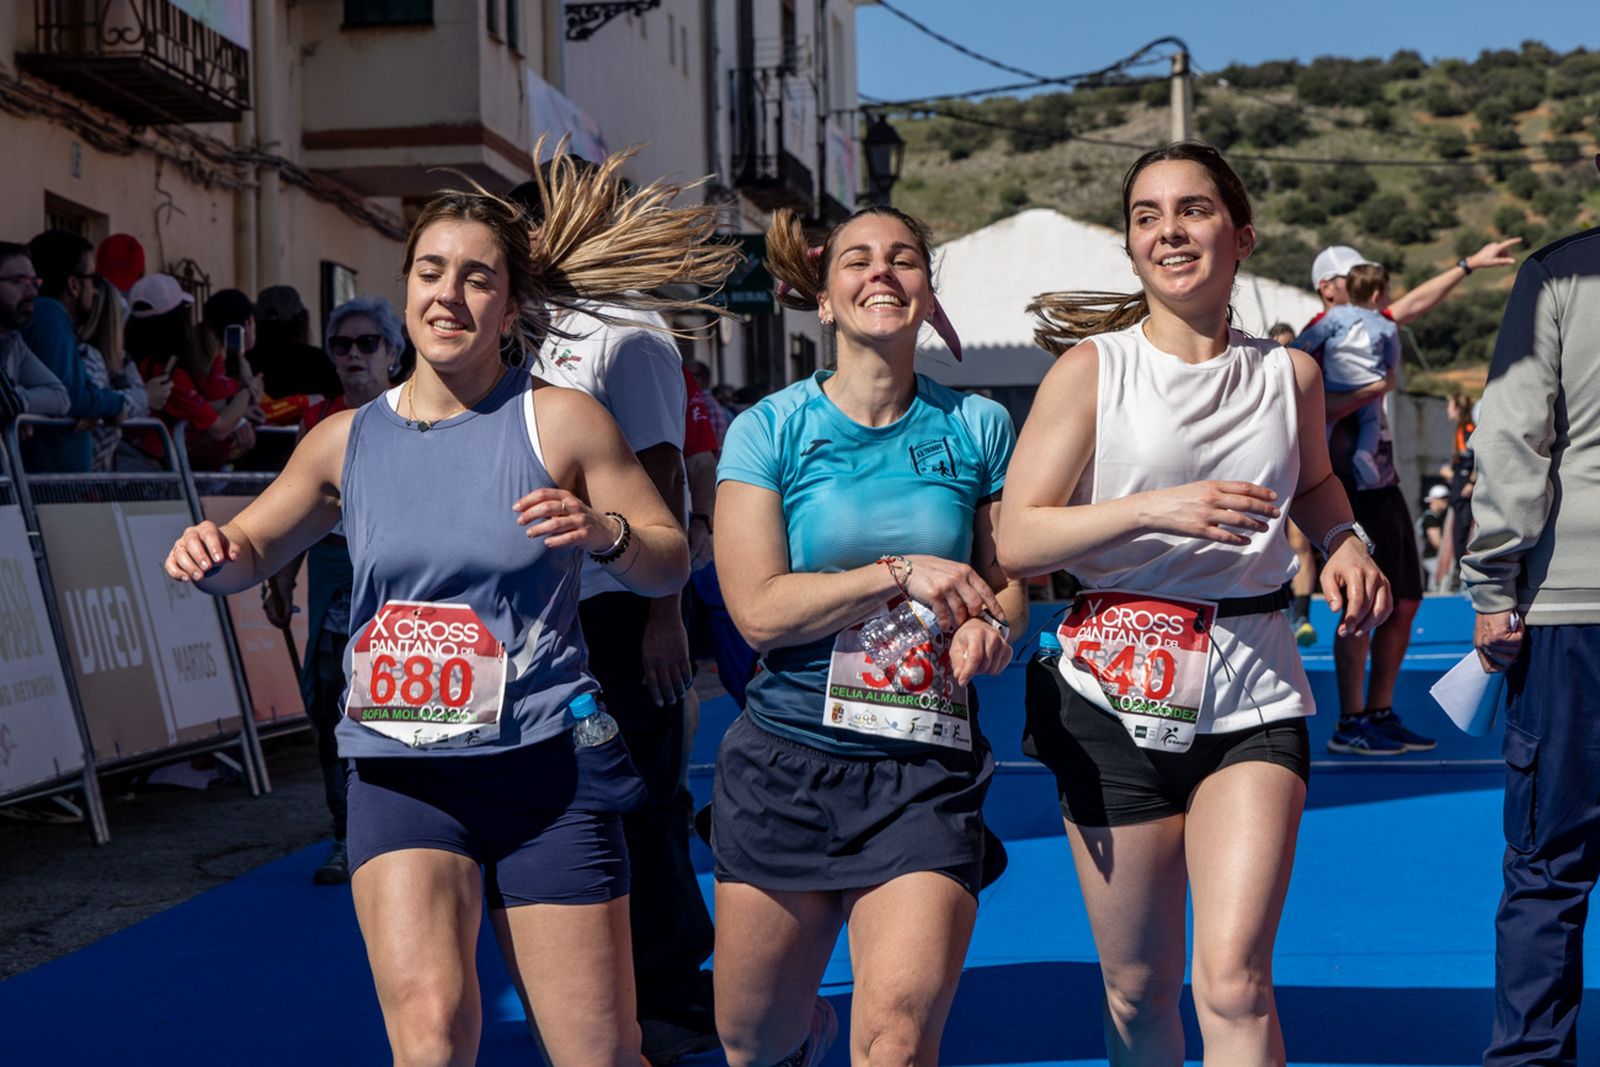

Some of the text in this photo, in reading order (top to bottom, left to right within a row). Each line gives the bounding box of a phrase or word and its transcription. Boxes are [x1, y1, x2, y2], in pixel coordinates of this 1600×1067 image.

[64, 585, 143, 675] UNED
[370, 610, 479, 643] X CROSS
[1082, 599, 1185, 636] X CROSS
[369, 638, 477, 658] PANTANO DEL
[1075, 626, 1180, 651] PANTANO DEL
[172, 641, 218, 683] MARTOS
[370, 654, 472, 707] 680
[830, 686, 864, 700] CELIA
[362, 708, 389, 721] SOFIA
